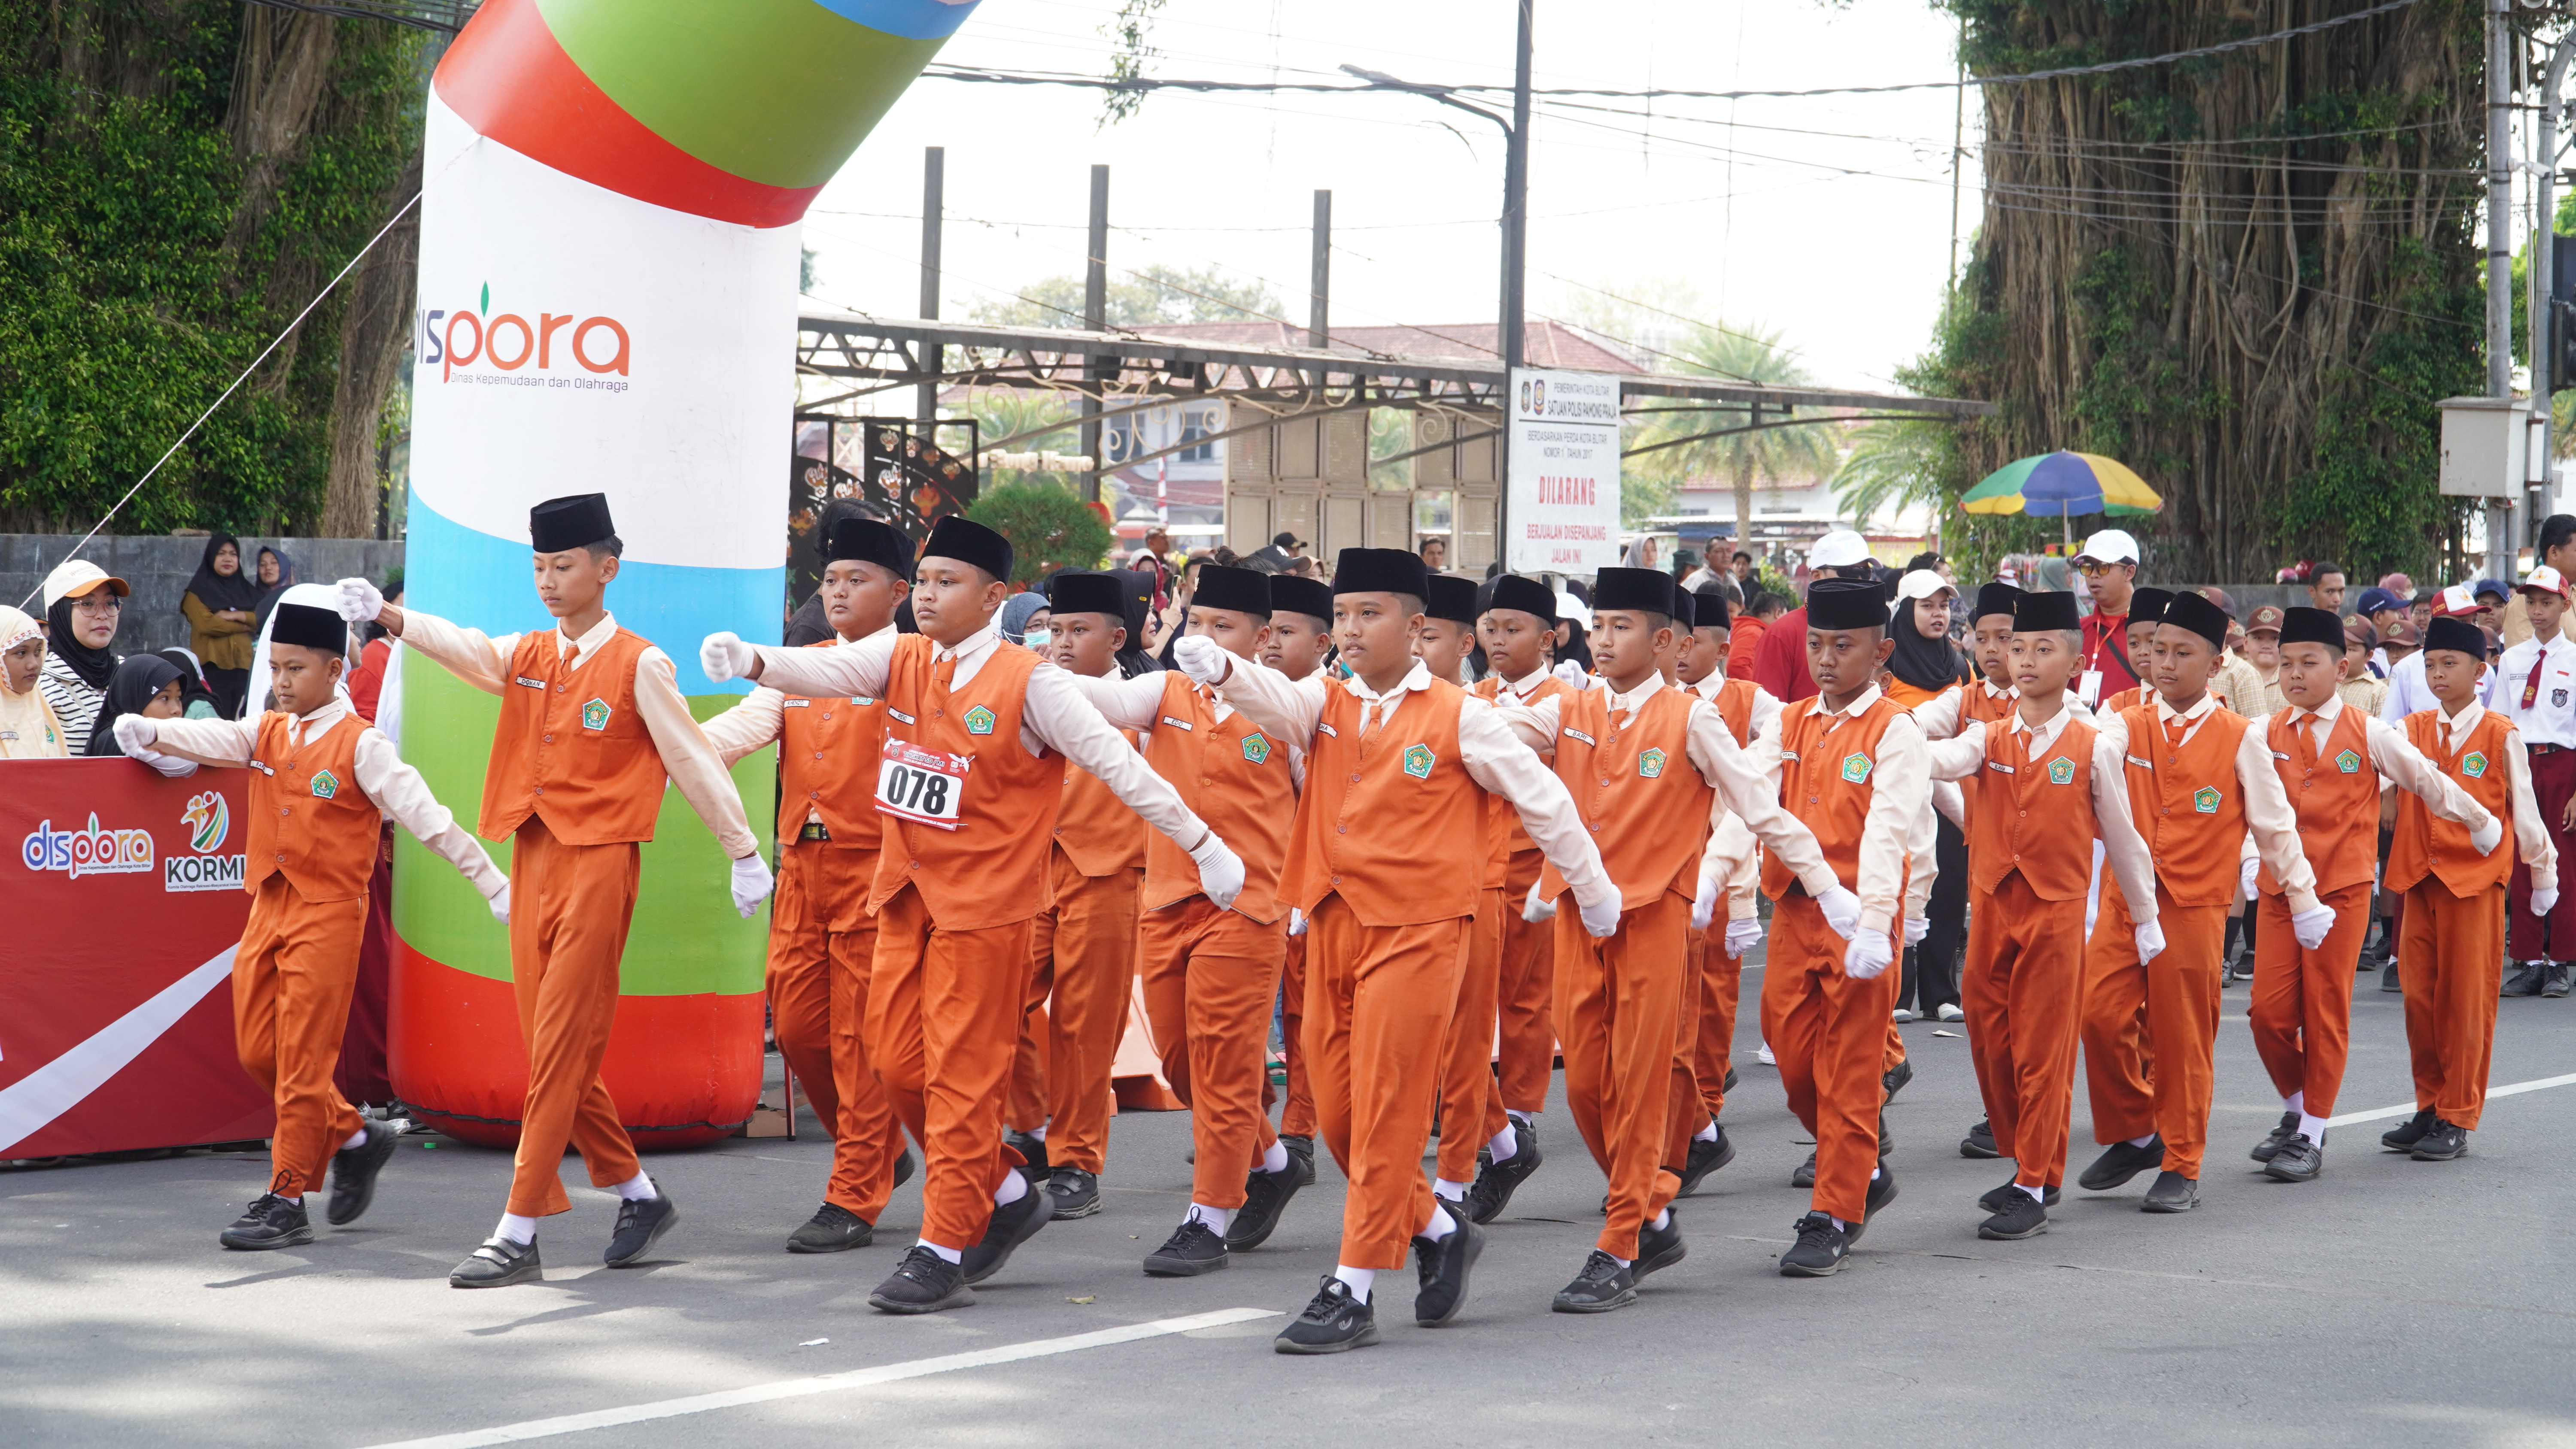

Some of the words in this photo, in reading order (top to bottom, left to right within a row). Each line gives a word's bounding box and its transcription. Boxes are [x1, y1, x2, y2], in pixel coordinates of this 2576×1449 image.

[451, 372, 473, 383] Dinas
[476, 373, 544, 387] Kepemudaan
[549, 376, 570, 388] dan
[574, 378, 629, 393] Olahraga
[1554, 383, 1582, 394] PEMERINTAH
[1548, 400, 1567, 416] SATUAN
[1567, 400, 1583, 418] POLISI
[1583, 402, 1602, 418] PAMONG
[1602, 403, 1617, 419] PRAJA
[1528, 430, 1563, 442] BERDASARKAN
[1564, 432, 1579, 443] PERDA
[1580, 433, 1591, 443] KOTA
[1592, 433, 1607, 444] BLITAR
[1543, 447, 1560, 458] NOMOR
[1567, 448, 1582, 459] TAHUN
[1539, 476, 1595, 506] DILARANG
[1527, 524, 1563, 540] BERJUALAN
[1564, 525, 1606, 541] DISEPANJANG
[1551, 549, 1571, 564] JALAN
[1572, 549, 1581, 564] INI
[903, 751, 924, 762] TINGKAT
[887, 765, 948, 815] 078
[26, 824, 151, 877] dispora
[168, 857, 244, 883] KORMI
